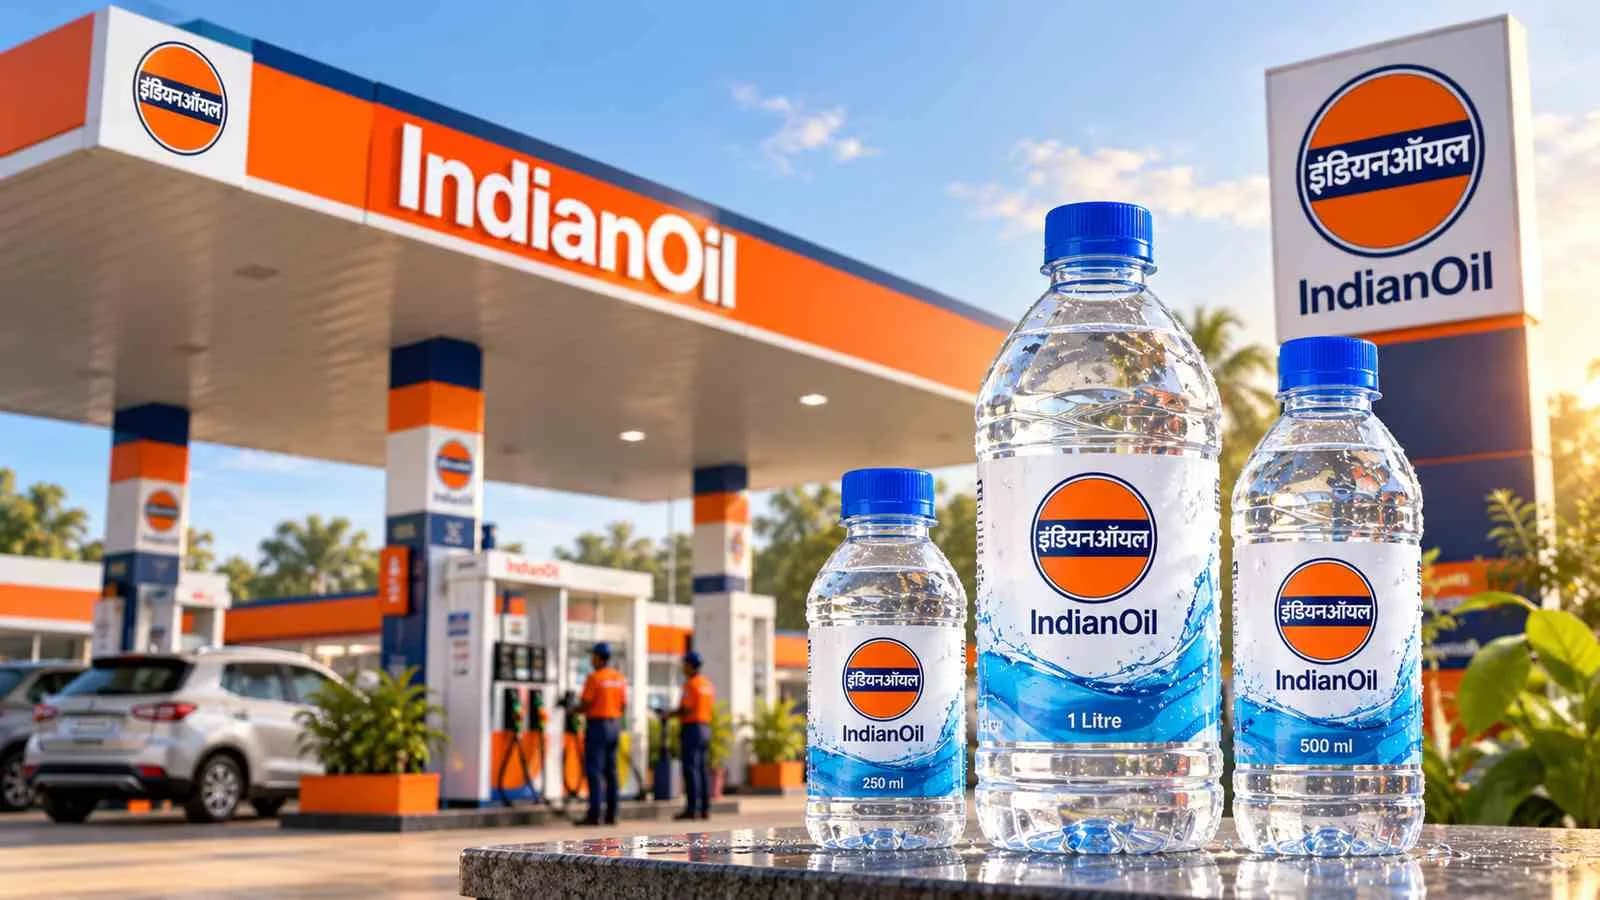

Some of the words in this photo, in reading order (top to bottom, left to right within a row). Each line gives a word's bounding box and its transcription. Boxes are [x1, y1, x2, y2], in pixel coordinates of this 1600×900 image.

[140, 77, 222, 119] इंडियनऑयल
[1308, 134, 1472, 195] इंडियनऑयल
[399, 123, 736, 309] IndianOil
[1299, 251, 1493, 316] IndianOil
[1038, 525, 1149, 552] इंडियनऑयल
[1031, 609, 1158, 635] IndianOil
[1281, 601, 1371, 623] इंडियनऑयल
[847, 671, 920, 689] इंडियनऑयल
[1275, 669, 1378, 691] IndianOil
[1067, 713, 1076, 729] 1
[1081, 712, 1122, 729] Litre
[843, 725, 924, 743] IndianOil
[1300, 738, 1329, 753] 500
[1334, 738, 1353, 753] ml
[863, 777, 886, 790] 250
[889, 777, 904, 789] ml
